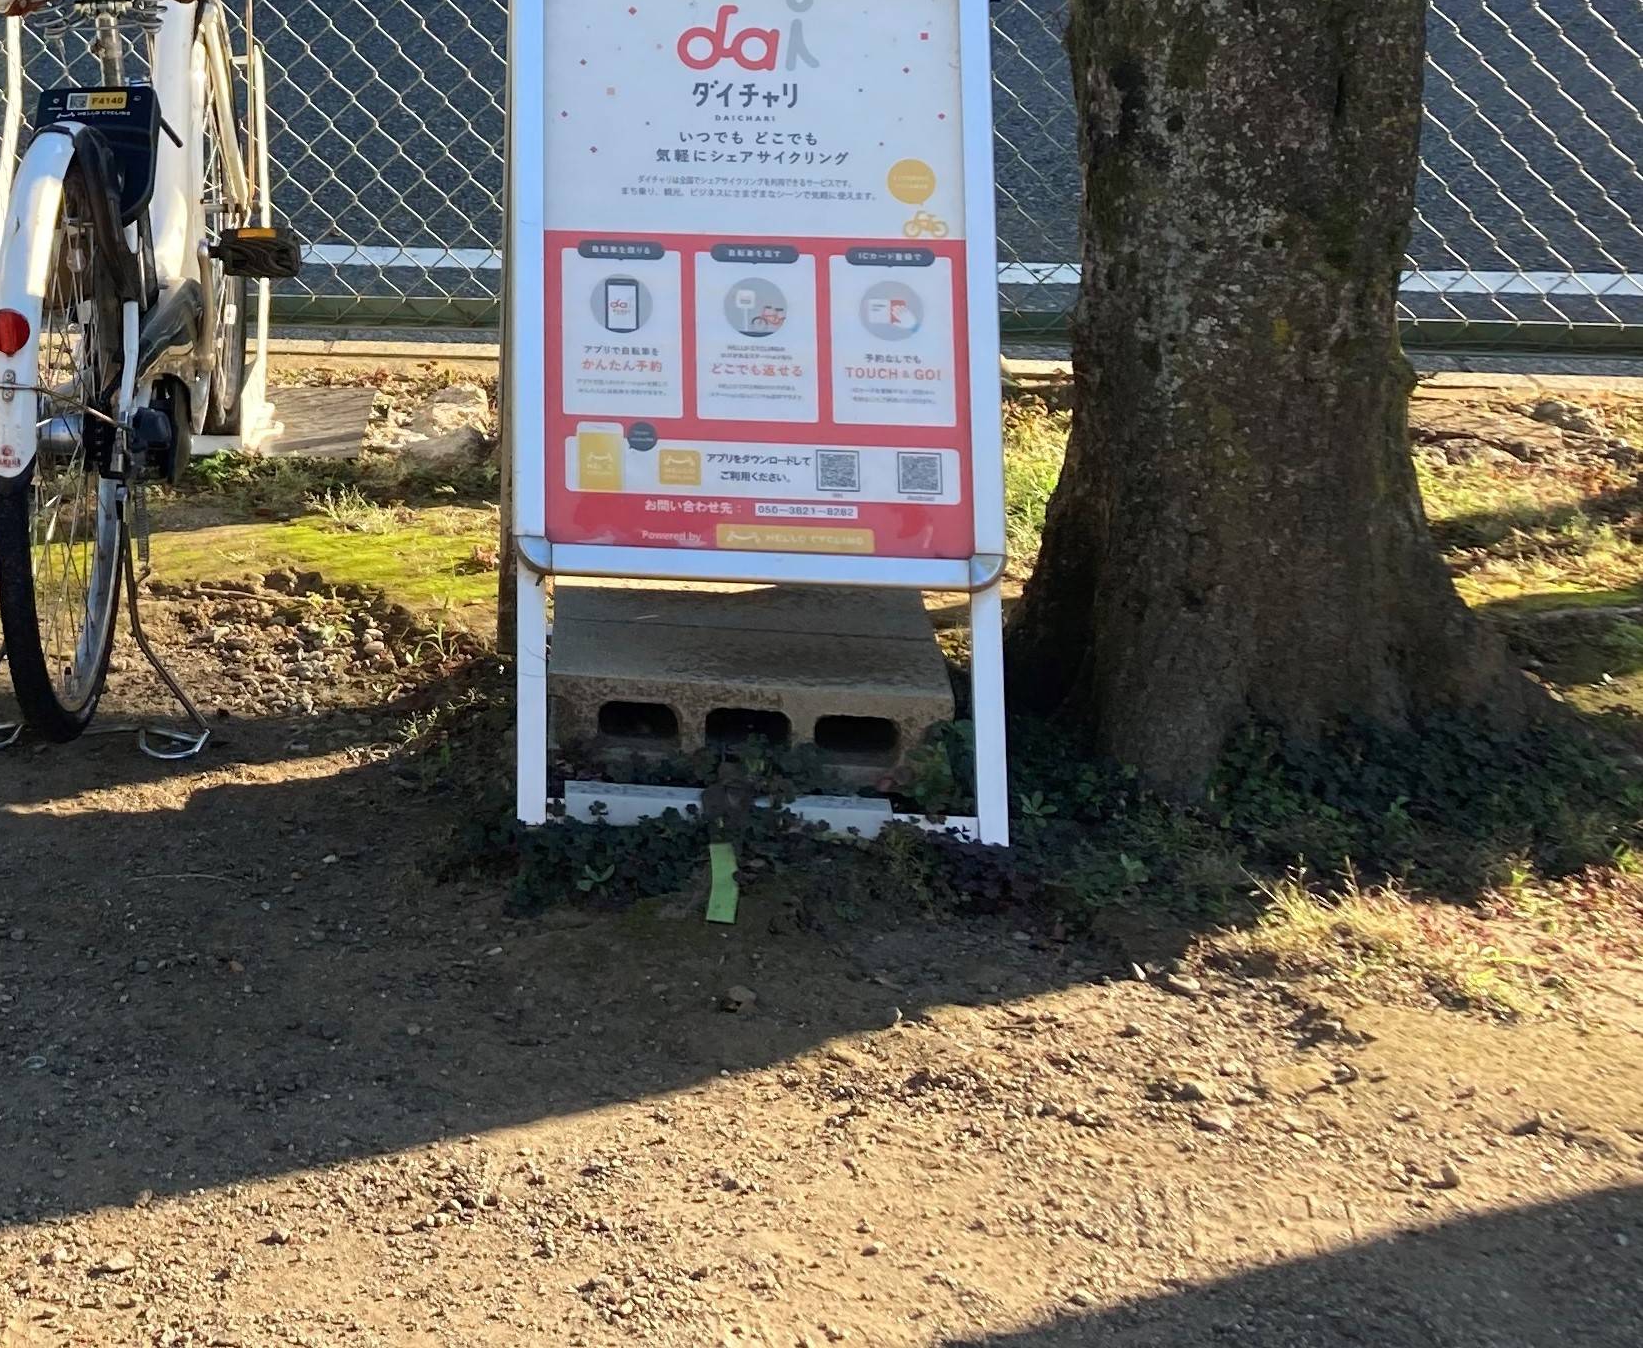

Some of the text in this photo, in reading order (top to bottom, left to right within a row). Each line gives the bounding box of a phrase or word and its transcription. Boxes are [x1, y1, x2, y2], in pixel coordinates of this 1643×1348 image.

[692, 80, 798, 109] ダイチャリ
[714, 114, 776, 122] DAICHARI
[679, 131, 817, 146] いつでも どこでも
[656, 148, 849, 166] 気軽にシェアサイクリング
[584, 345, 660, 357] アプリで自転車を
[581, 358, 662, 373] かんたん予約
[865, 353, 922, 364] 予約なしでも
[711, 363, 803, 377] どこでも返せる
[845, 366, 898, 380] TOUCH
[914, 368, 942, 381] GO!
[706, 453, 811, 467] アプリをダウンロードして
[720, 471, 791, 483] ご利用ください。
[641, 530, 702, 542] Powered by
